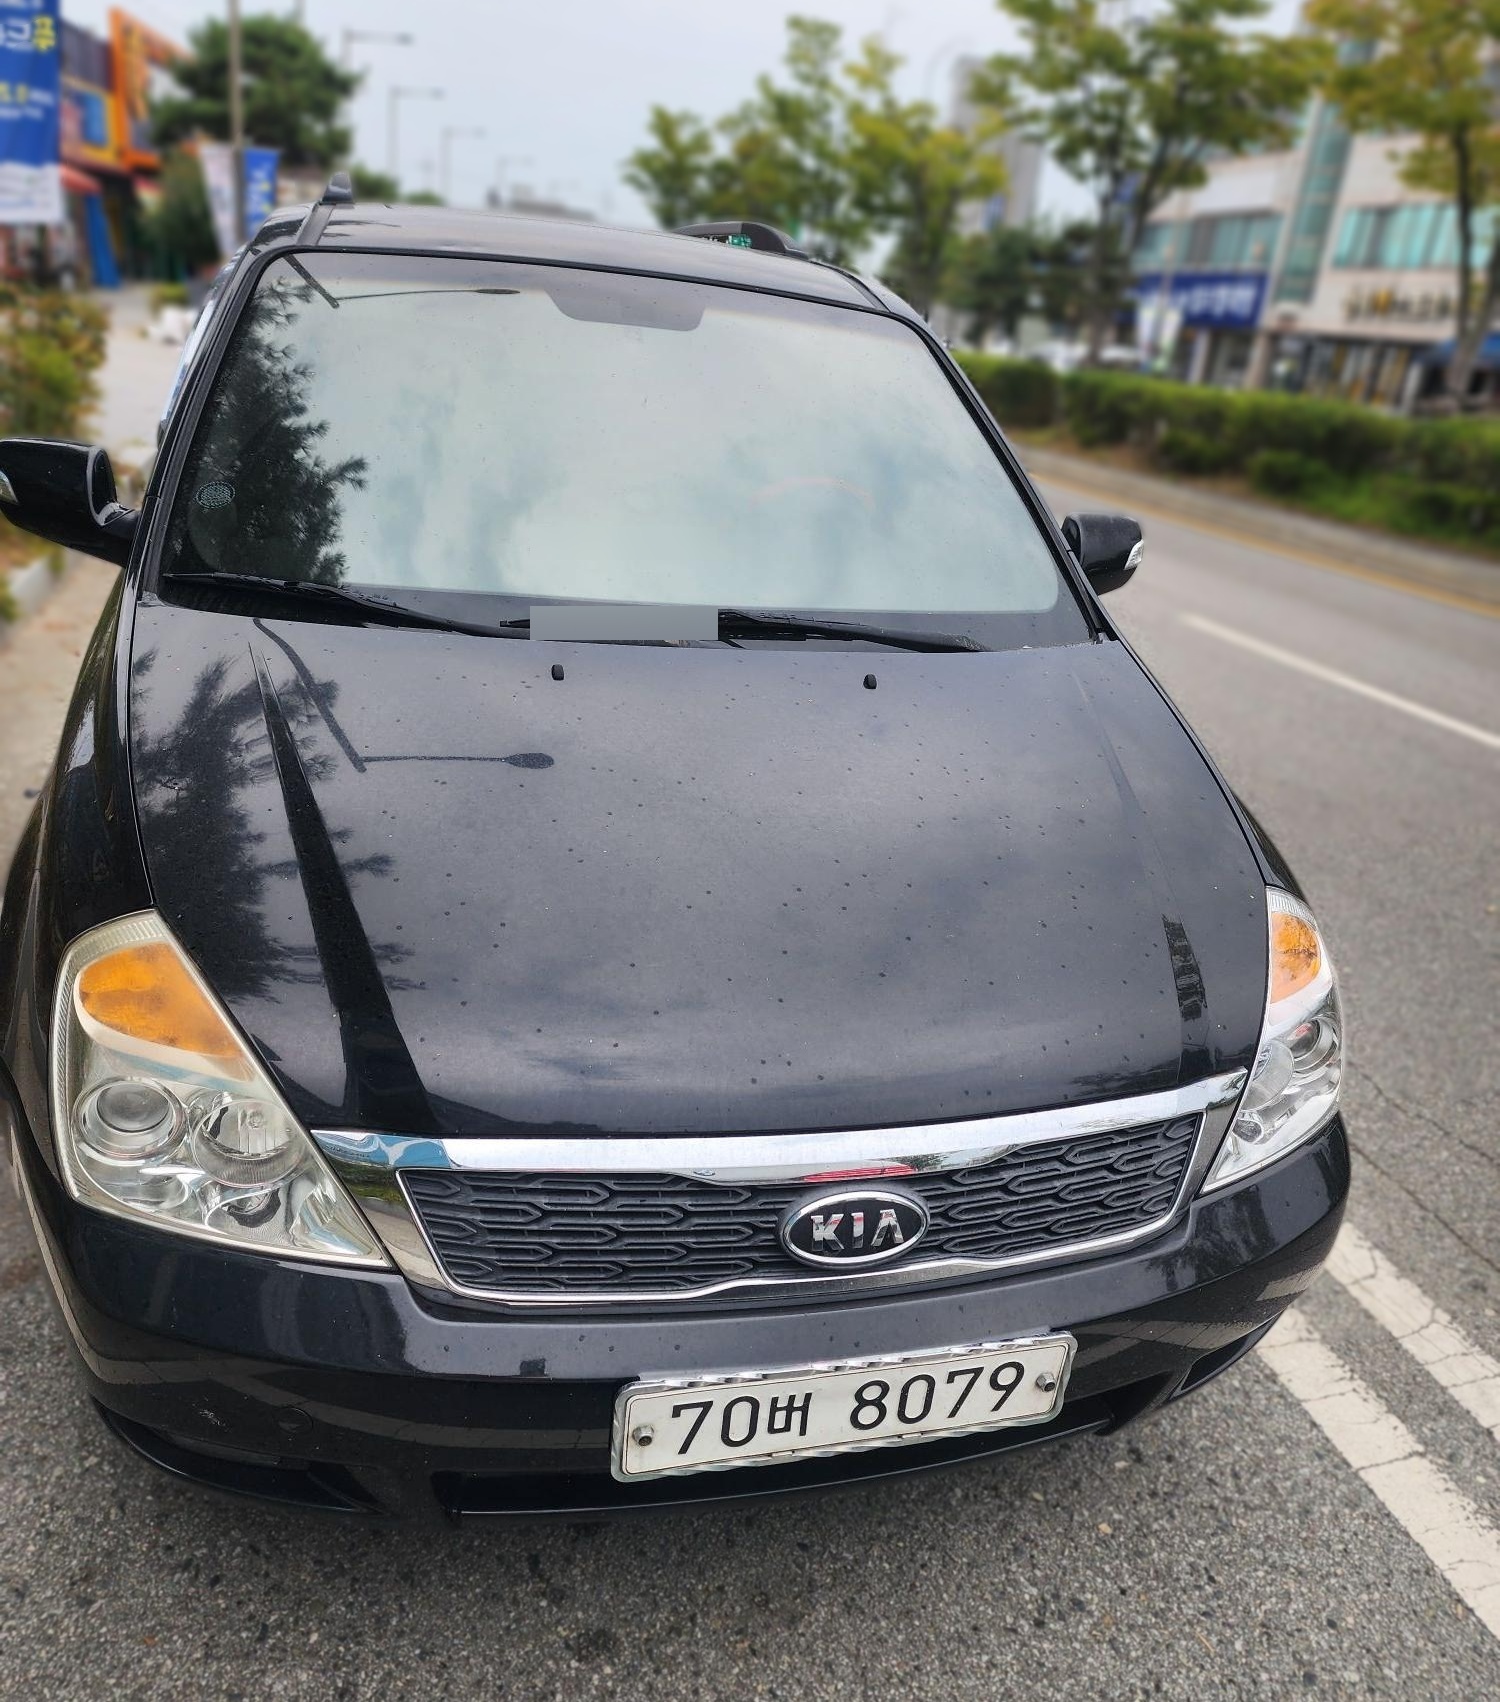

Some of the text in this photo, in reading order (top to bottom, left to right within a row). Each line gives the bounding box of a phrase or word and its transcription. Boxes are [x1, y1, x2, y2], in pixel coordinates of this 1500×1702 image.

[811, 1209, 904, 1250] KIA
[671, 1361, 1025, 1455] 70버 8079
